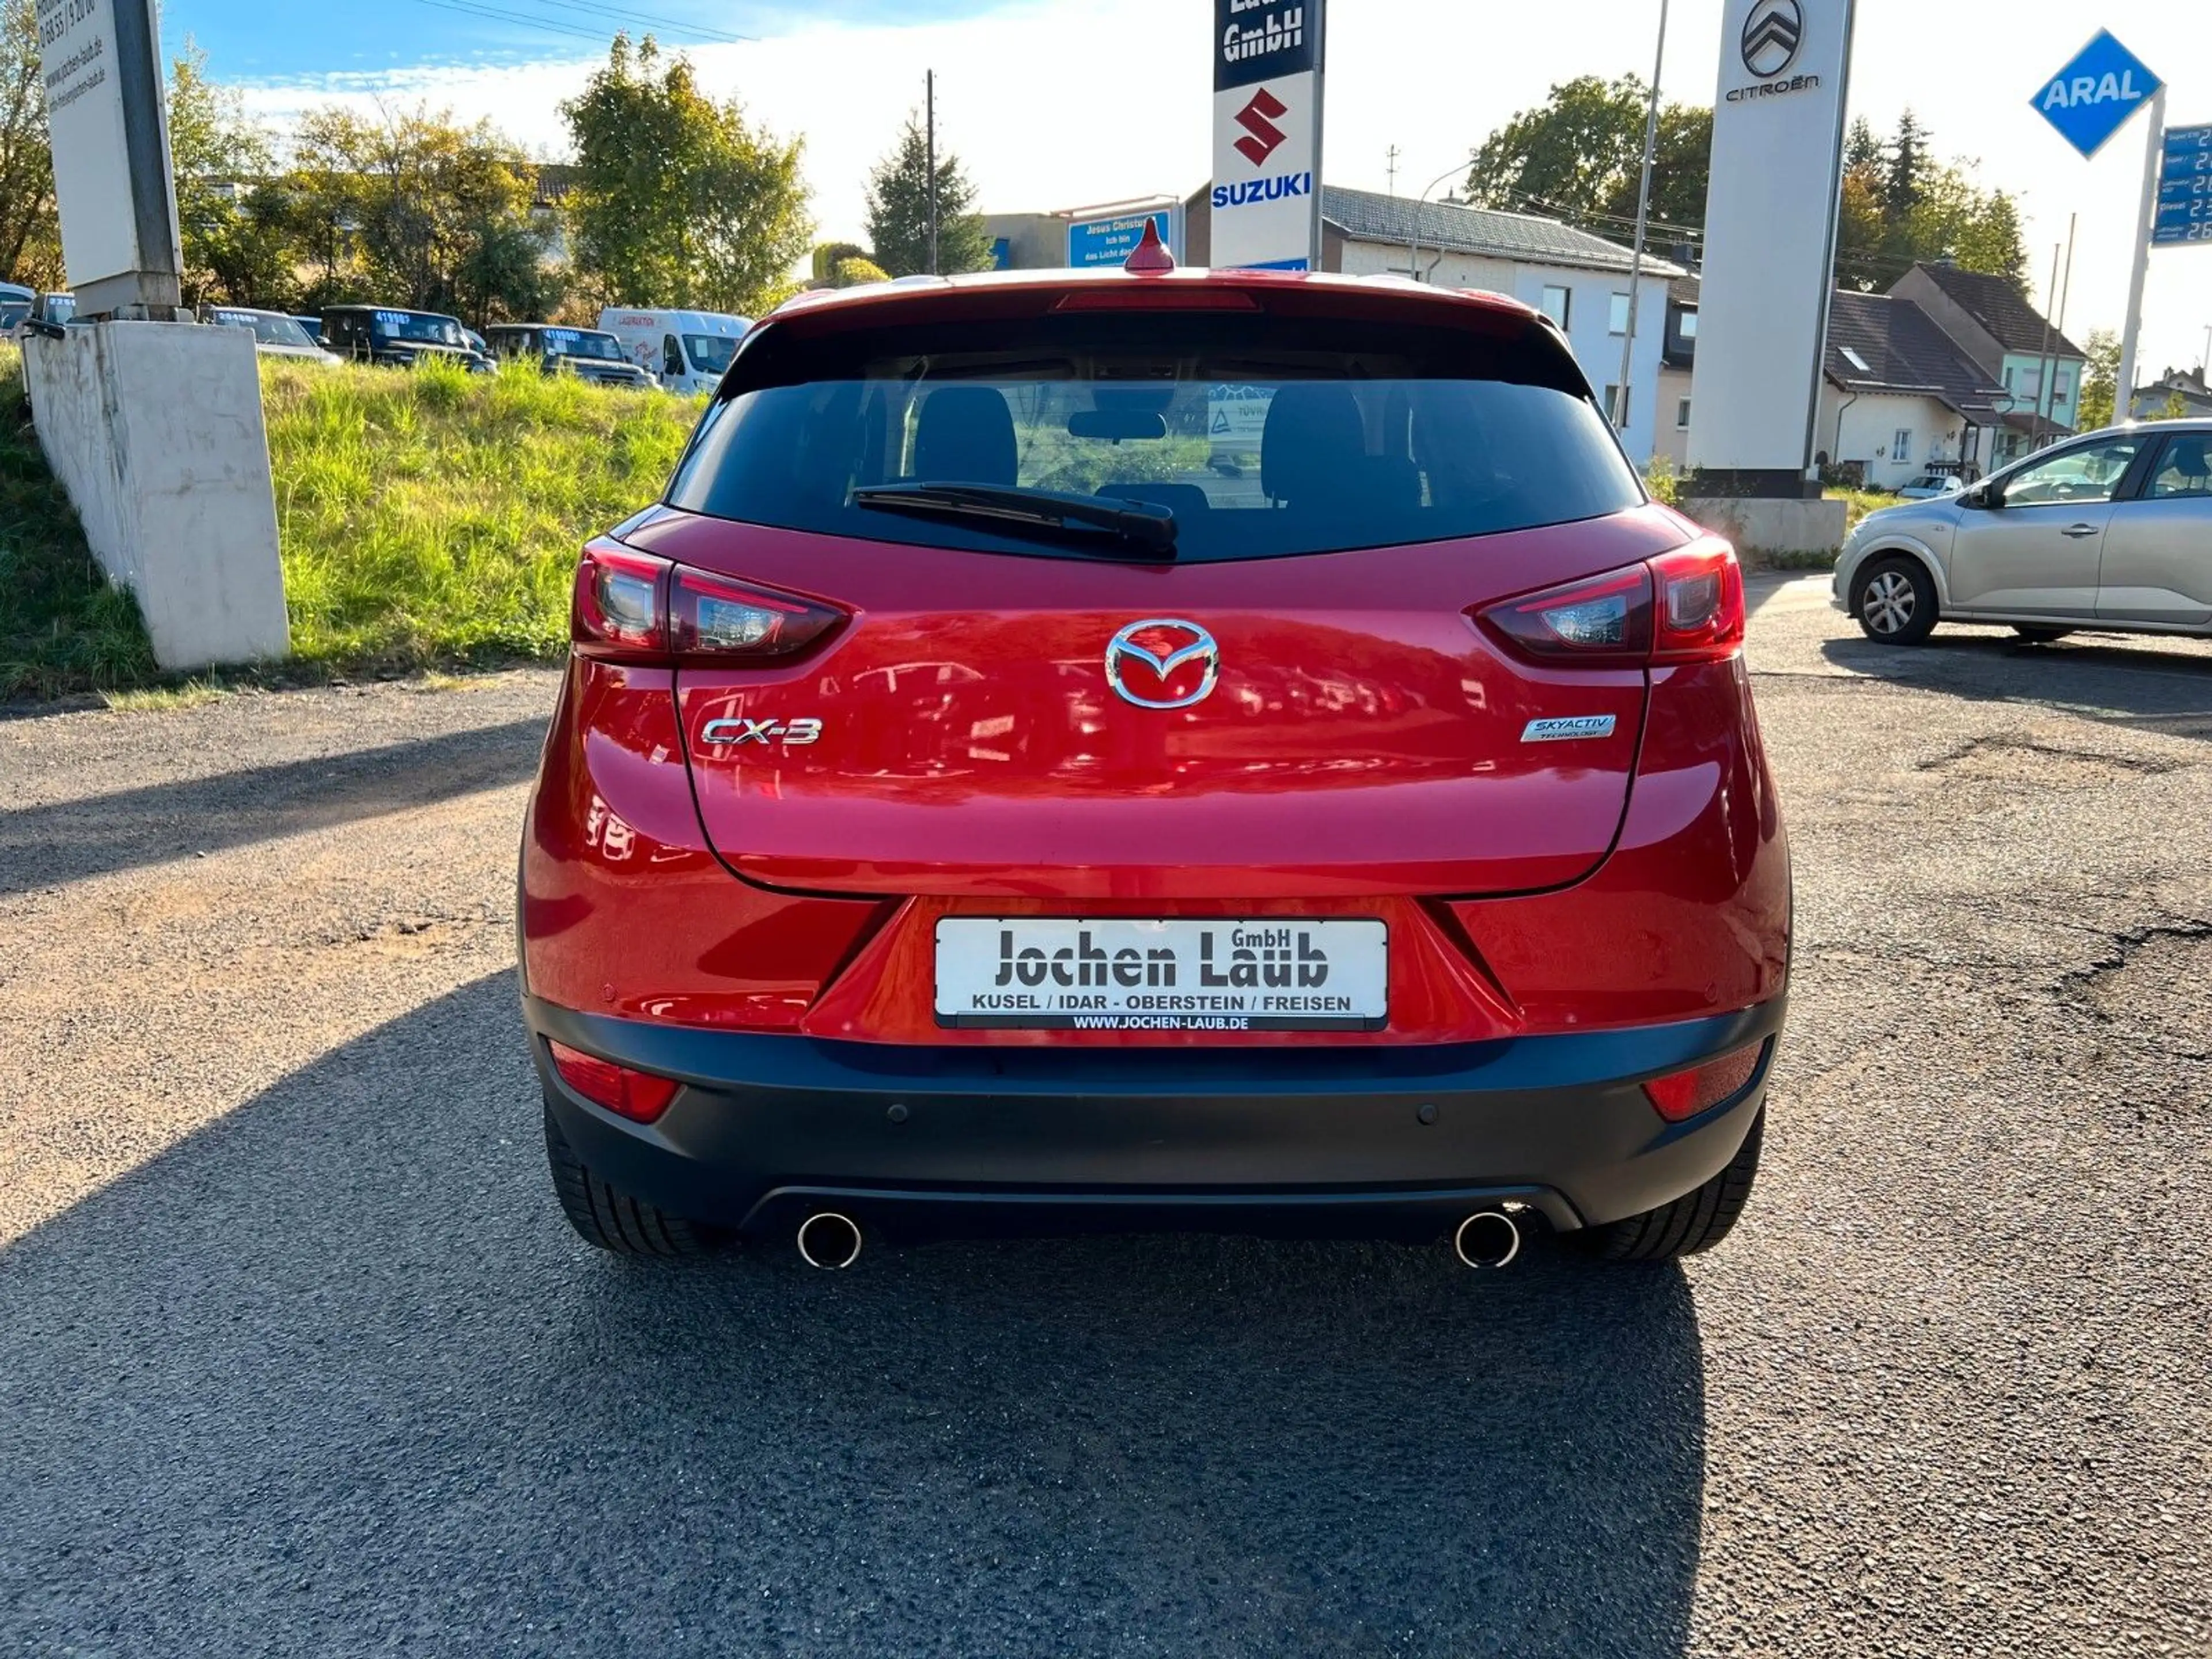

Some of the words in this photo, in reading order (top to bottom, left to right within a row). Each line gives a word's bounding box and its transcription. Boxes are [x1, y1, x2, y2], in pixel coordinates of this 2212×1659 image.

[1223, 6, 1302, 63] GmbH
[2043, 69, 2141, 111] ARAL
[1212, 172, 1311, 208] SUZUKI
[700, 718, 823, 745] CX-3
[1534, 717, 1608, 731] SKYACTIV
[1232, 929, 1290, 948] GmbH
[995, 930, 1176, 987] Jochen
[1200, 931, 1328, 988] Laub
[972, 994, 1041, 1009] KUSEL
[1046, 994, 1052, 1009] /
[1059, 995, 1107, 1009] IDAR
[1126, 995, 1244, 1010] OBERSTEIN
[1251, 995, 1257, 1010] /
[1263, 996, 1351, 1011] FREISEN
[1073, 1016, 1249, 1030] WWW.JOCHEN-LAUB.DE
